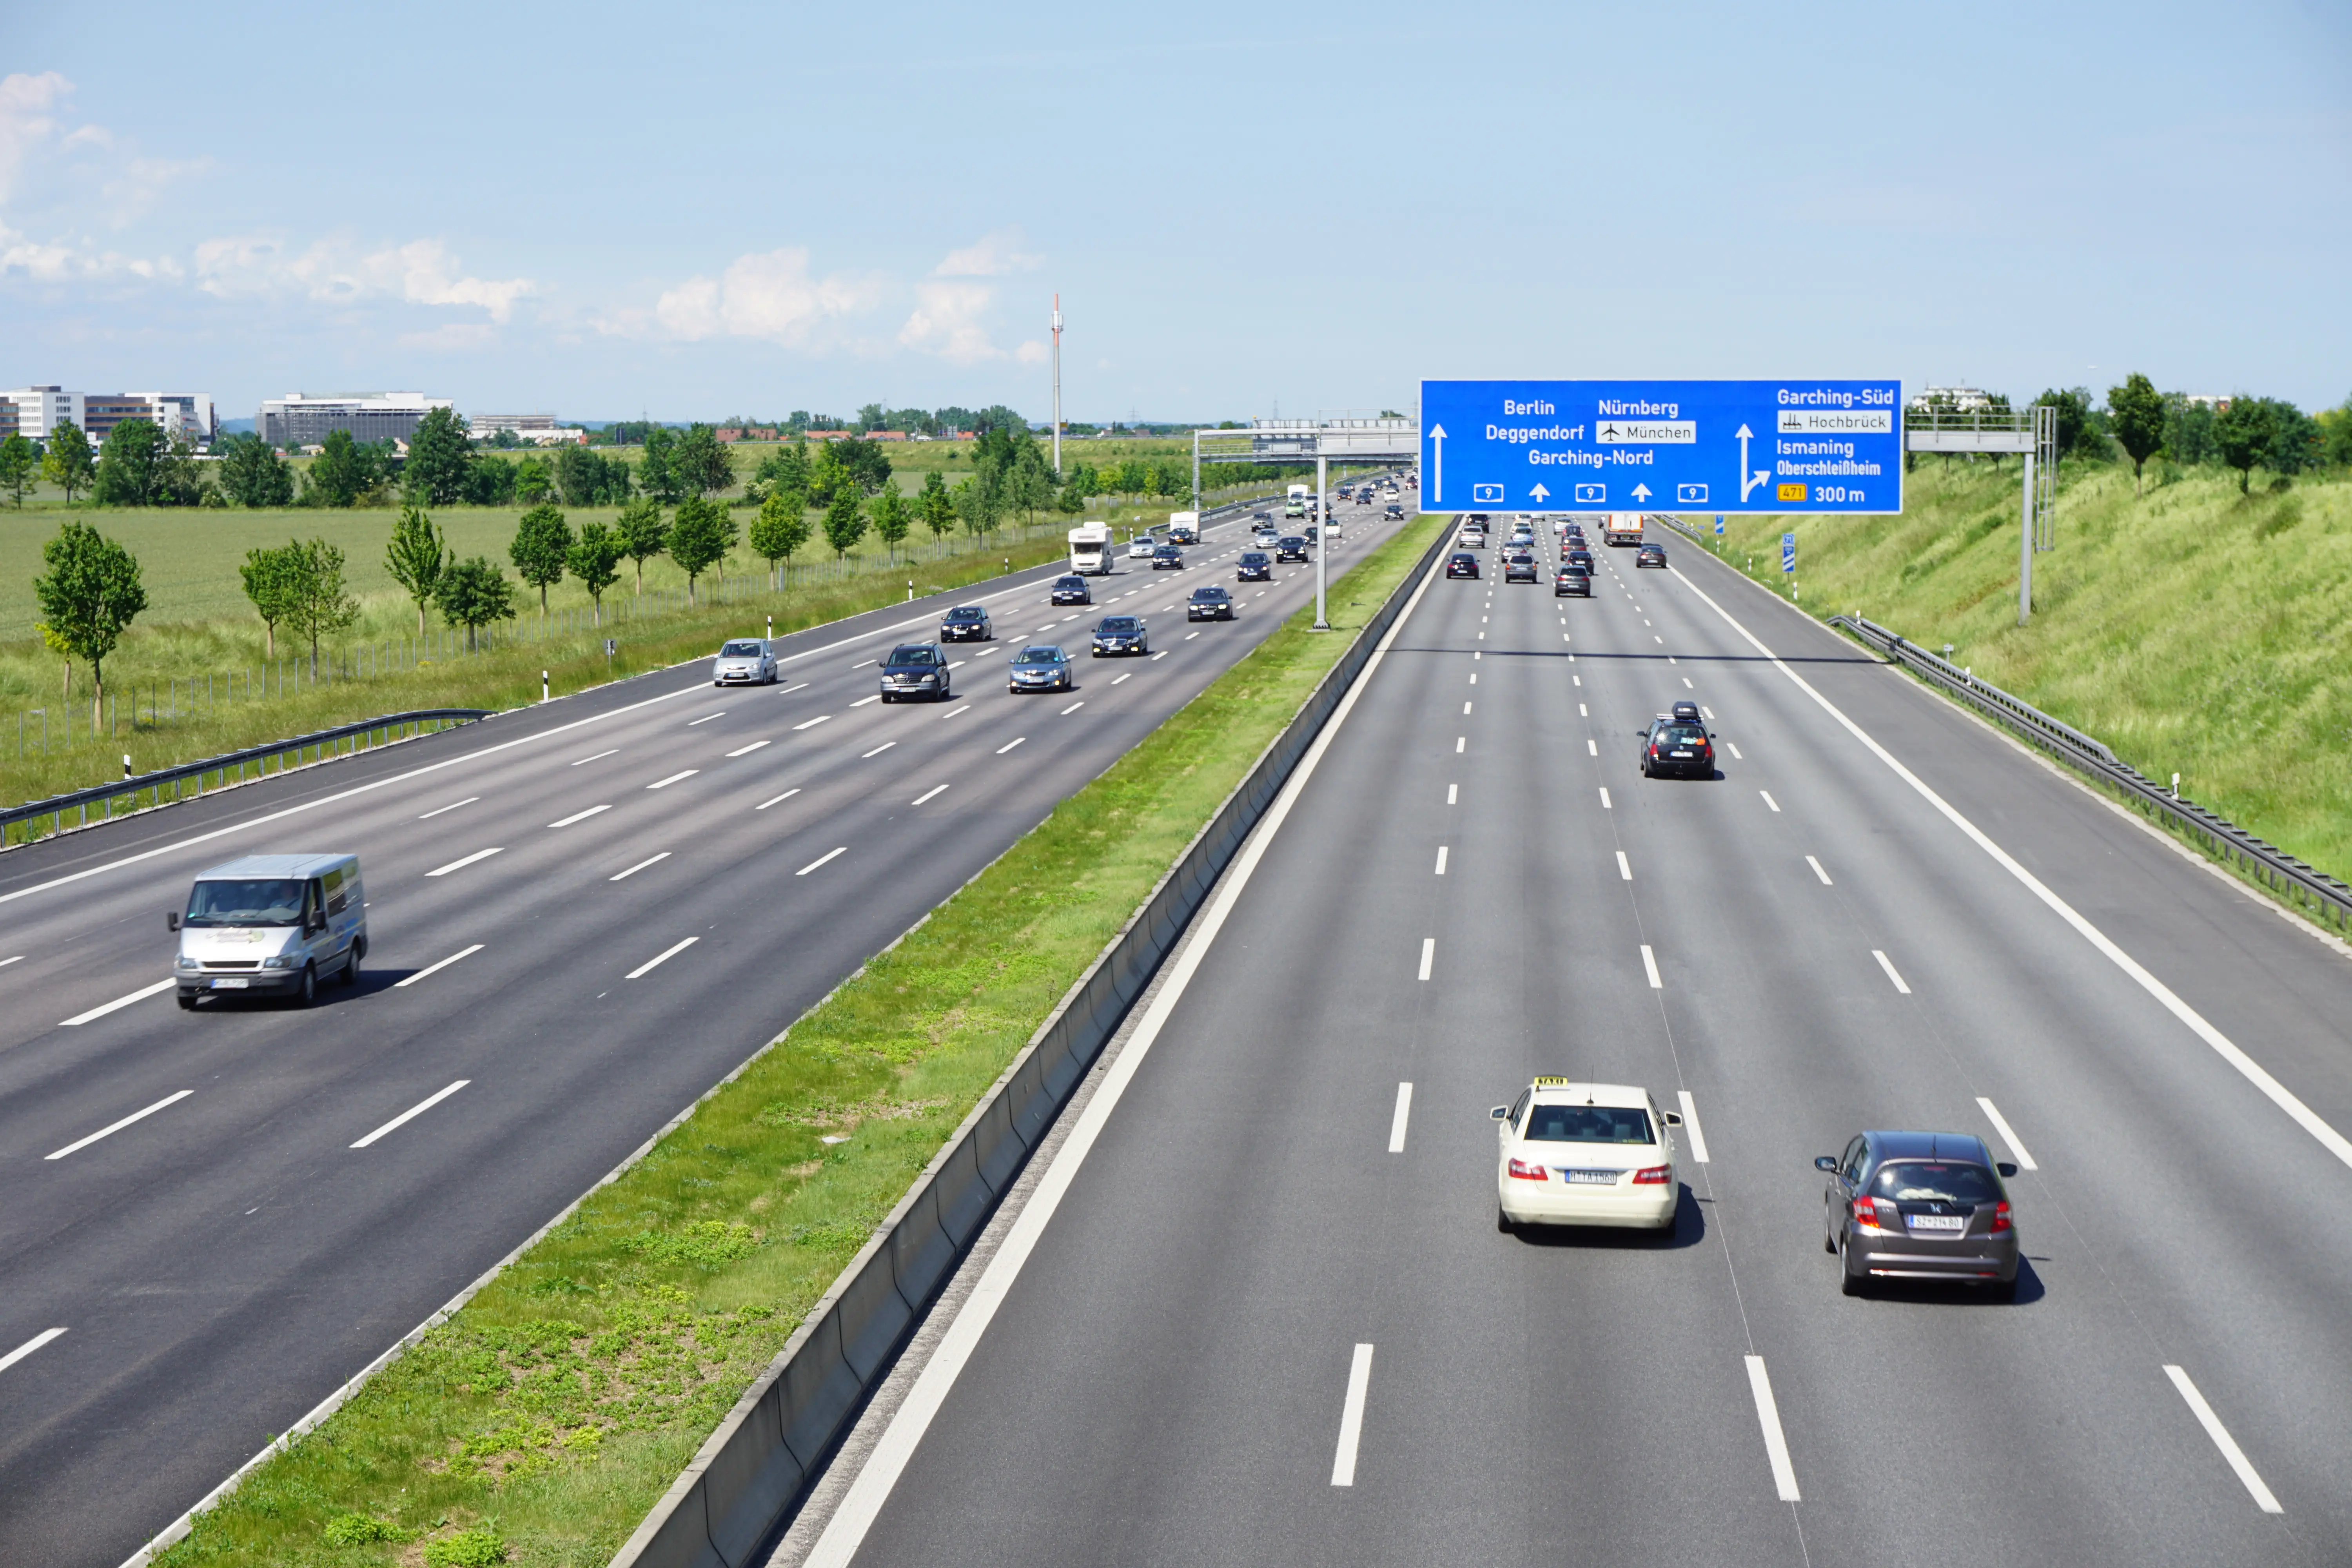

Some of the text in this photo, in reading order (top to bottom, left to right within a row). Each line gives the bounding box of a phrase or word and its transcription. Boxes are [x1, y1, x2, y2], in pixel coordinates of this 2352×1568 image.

[1777, 389, 1893, 408] Garching-Süd
[1504, 400, 1554, 415] Berlin
[1599, 399, 1678, 419] Nürnberg
[1809, 416, 1886, 428] Hochbrück
[1486, 425, 1584, 444] Deggendorf
[1627, 426, 1690, 438] München
[1777, 439, 1854, 458] Ismaning
[1528, 449, 1653, 468] Garching-Nord
[1777, 460, 1881, 476] Oberschleißheim
[1485, 488, 1493, 499] 9
[1587, 488, 1594, 499] 9
[1688, 488, 1697, 499] 9
[1783, 488, 1802, 497] 471
[1815, 486, 1865, 502] 300 m
